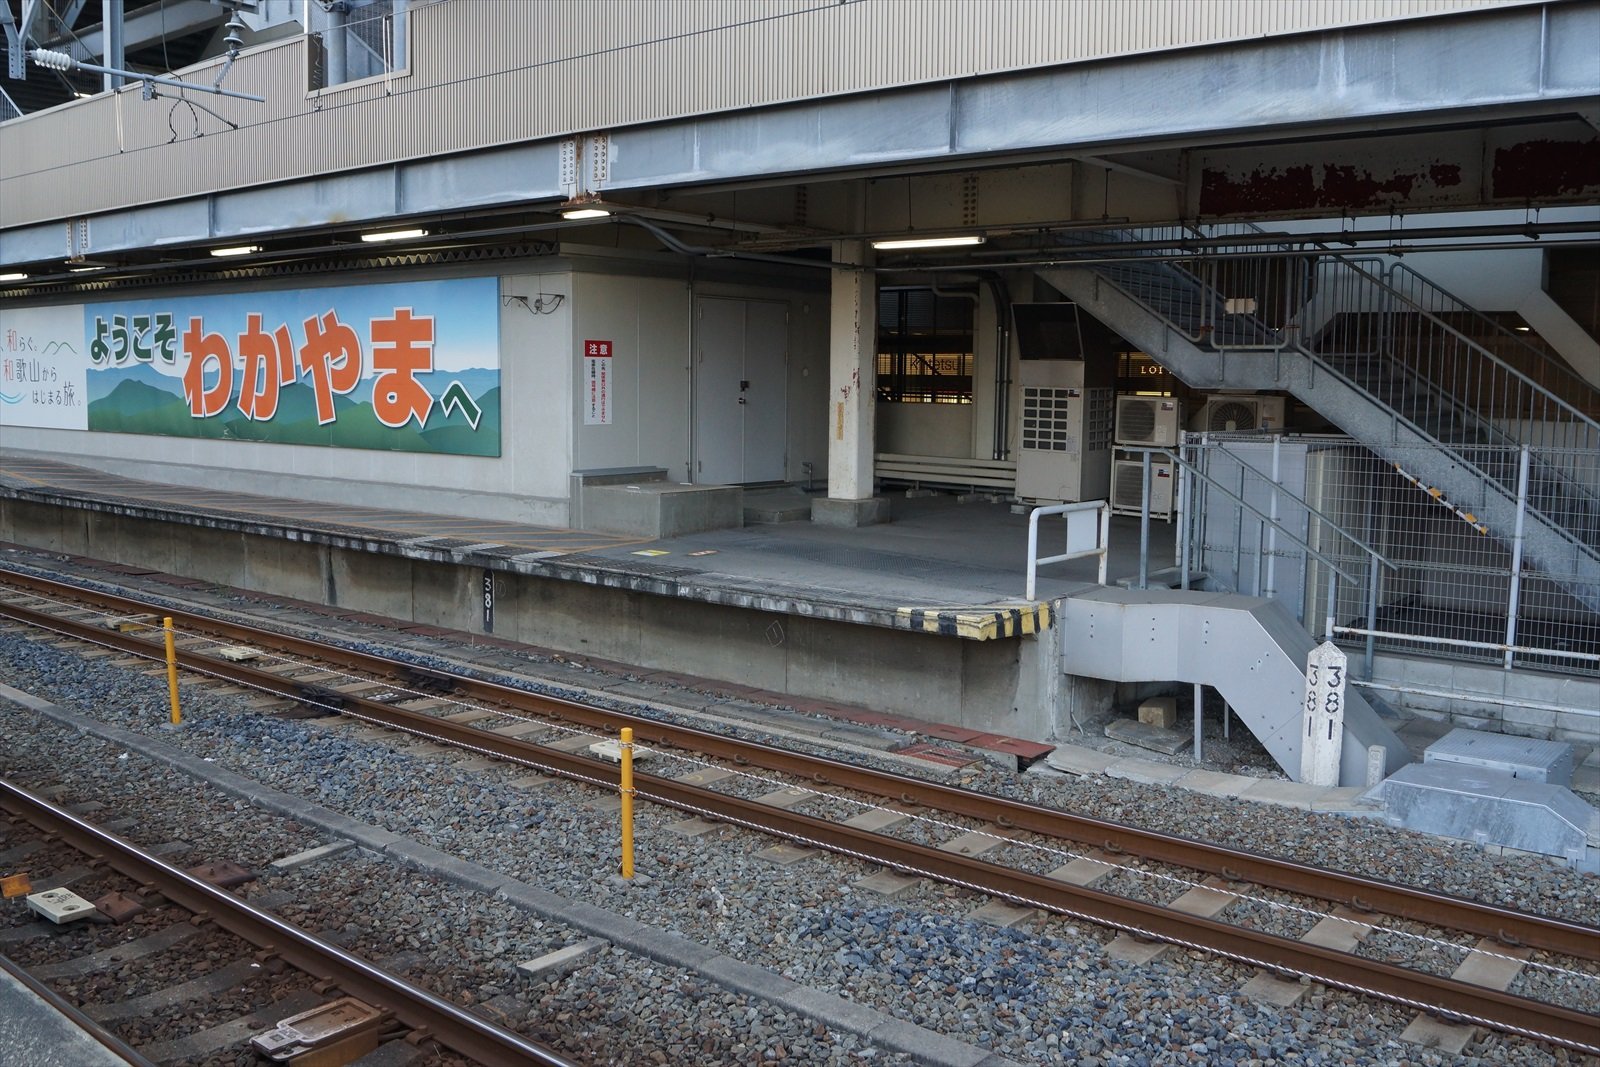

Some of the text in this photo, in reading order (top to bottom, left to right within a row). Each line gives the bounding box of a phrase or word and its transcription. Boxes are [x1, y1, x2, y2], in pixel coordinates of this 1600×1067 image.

[90, 312, 177, 364] ようこそ
[1306, 664, 1318, 737] 381
[1325, 666, 1341, 740] 381
